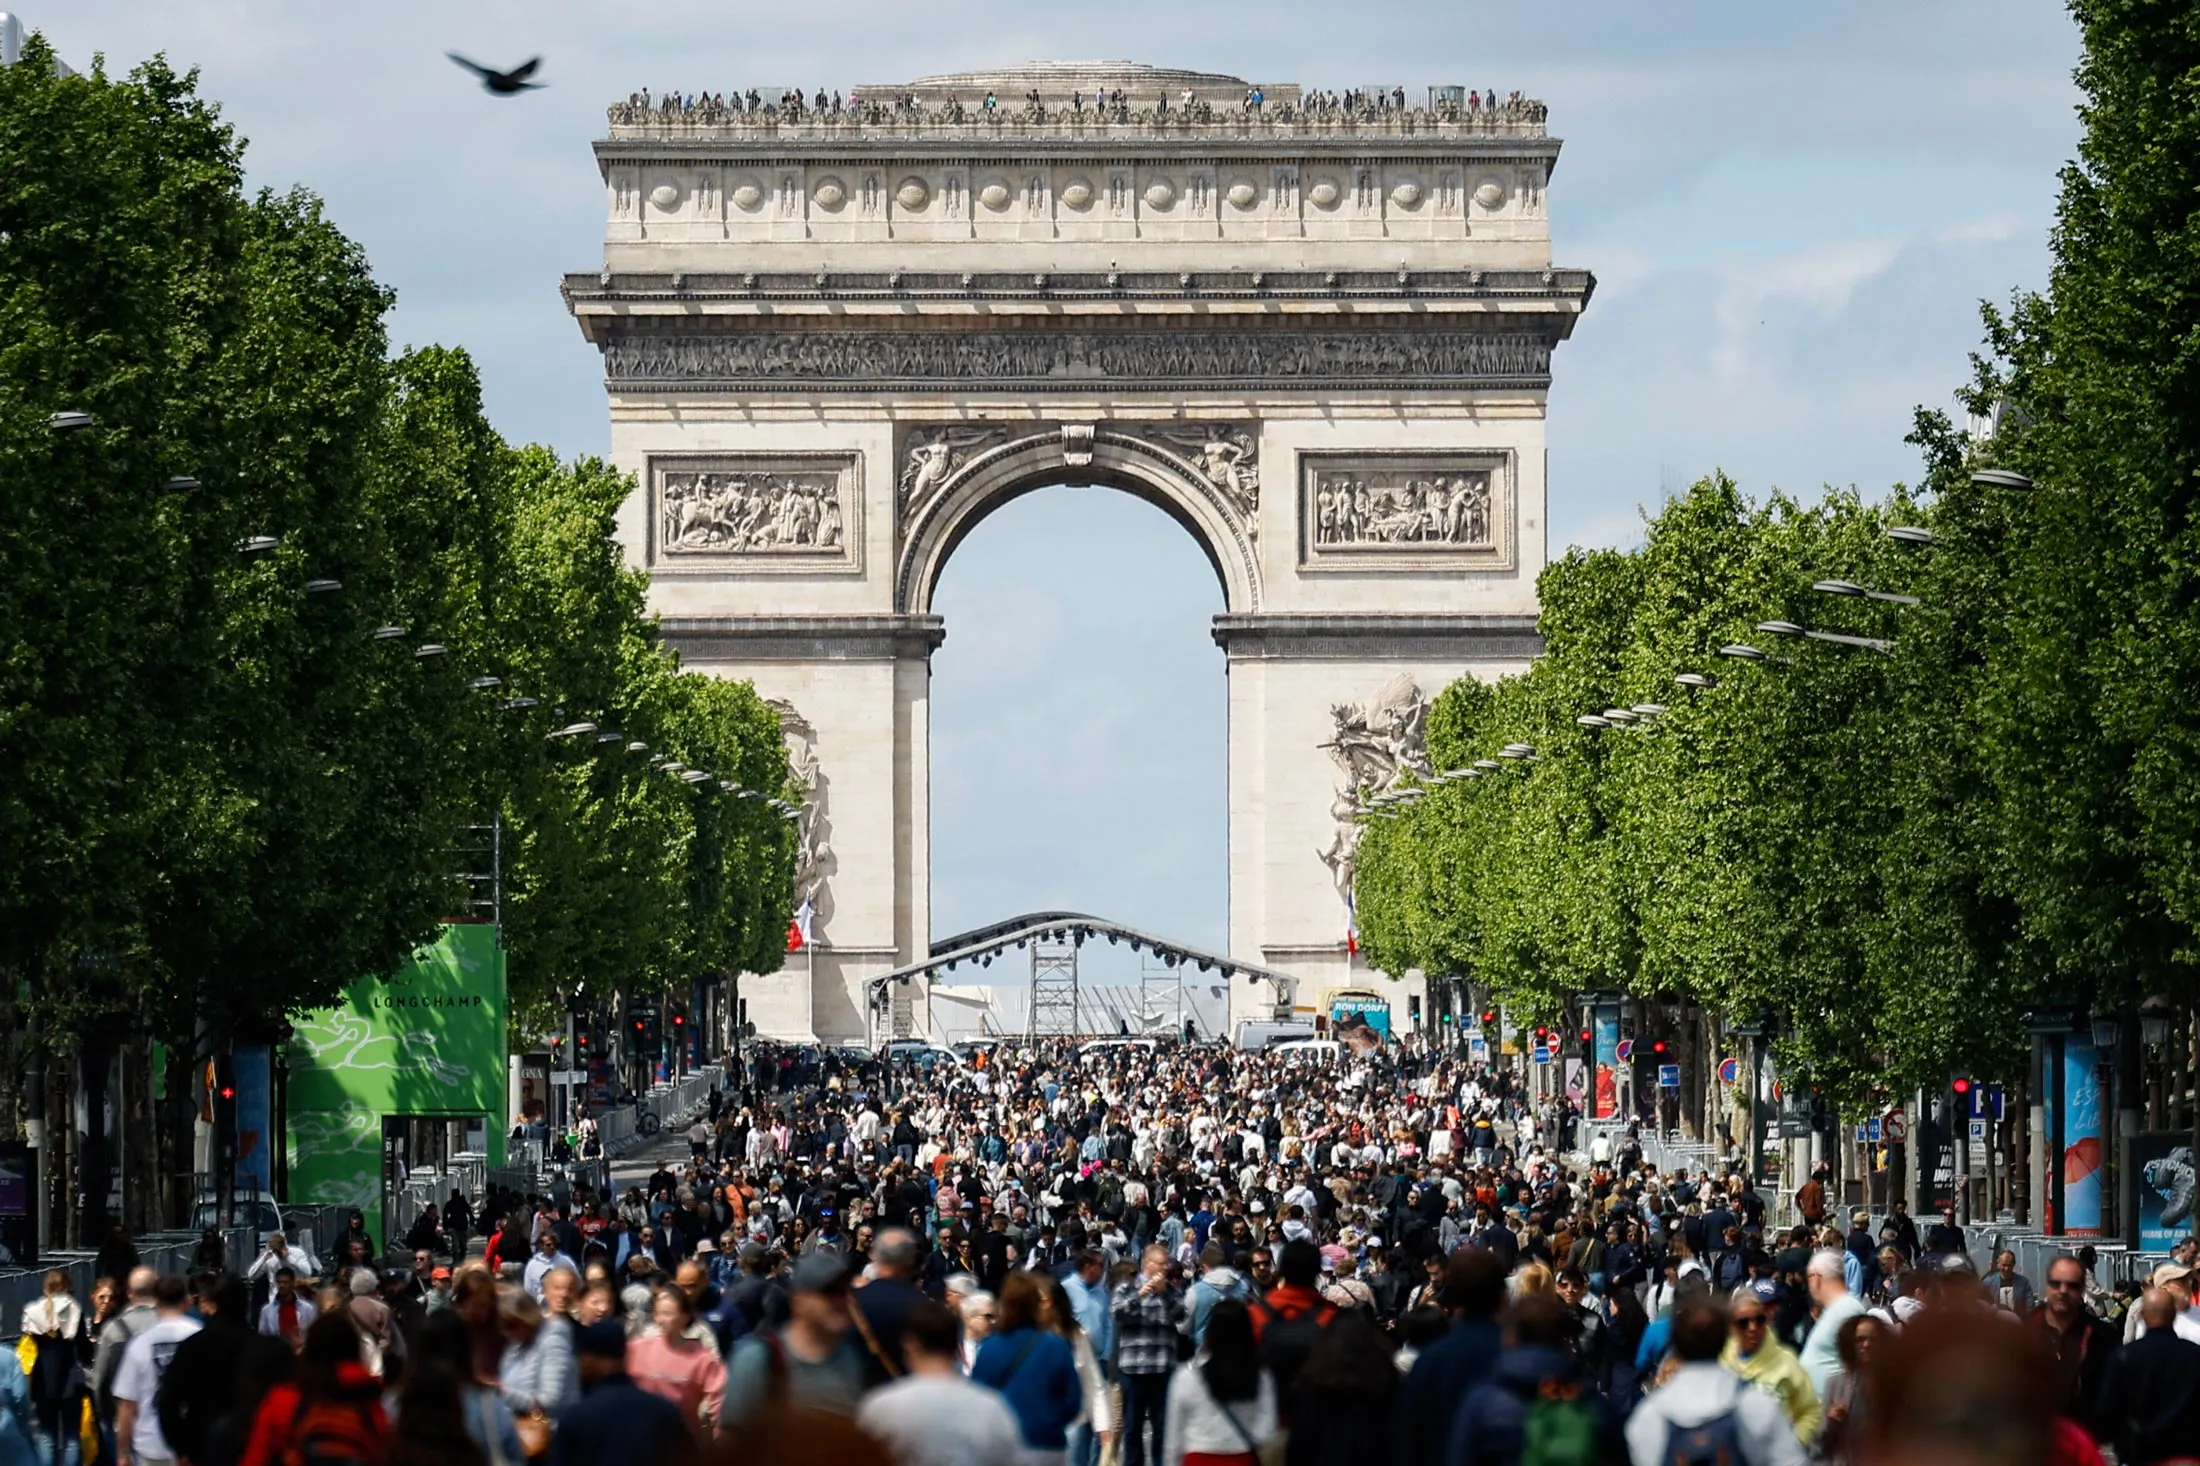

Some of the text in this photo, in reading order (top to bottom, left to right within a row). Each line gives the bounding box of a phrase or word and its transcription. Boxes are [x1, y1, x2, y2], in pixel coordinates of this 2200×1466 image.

[374, 995, 481, 1008] LONGCHAMP
[1335, 1002, 1355, 1011] RON
[1973, 1125, 1980, 1134] P
[2163, 1229, 2173, 1239] OF
